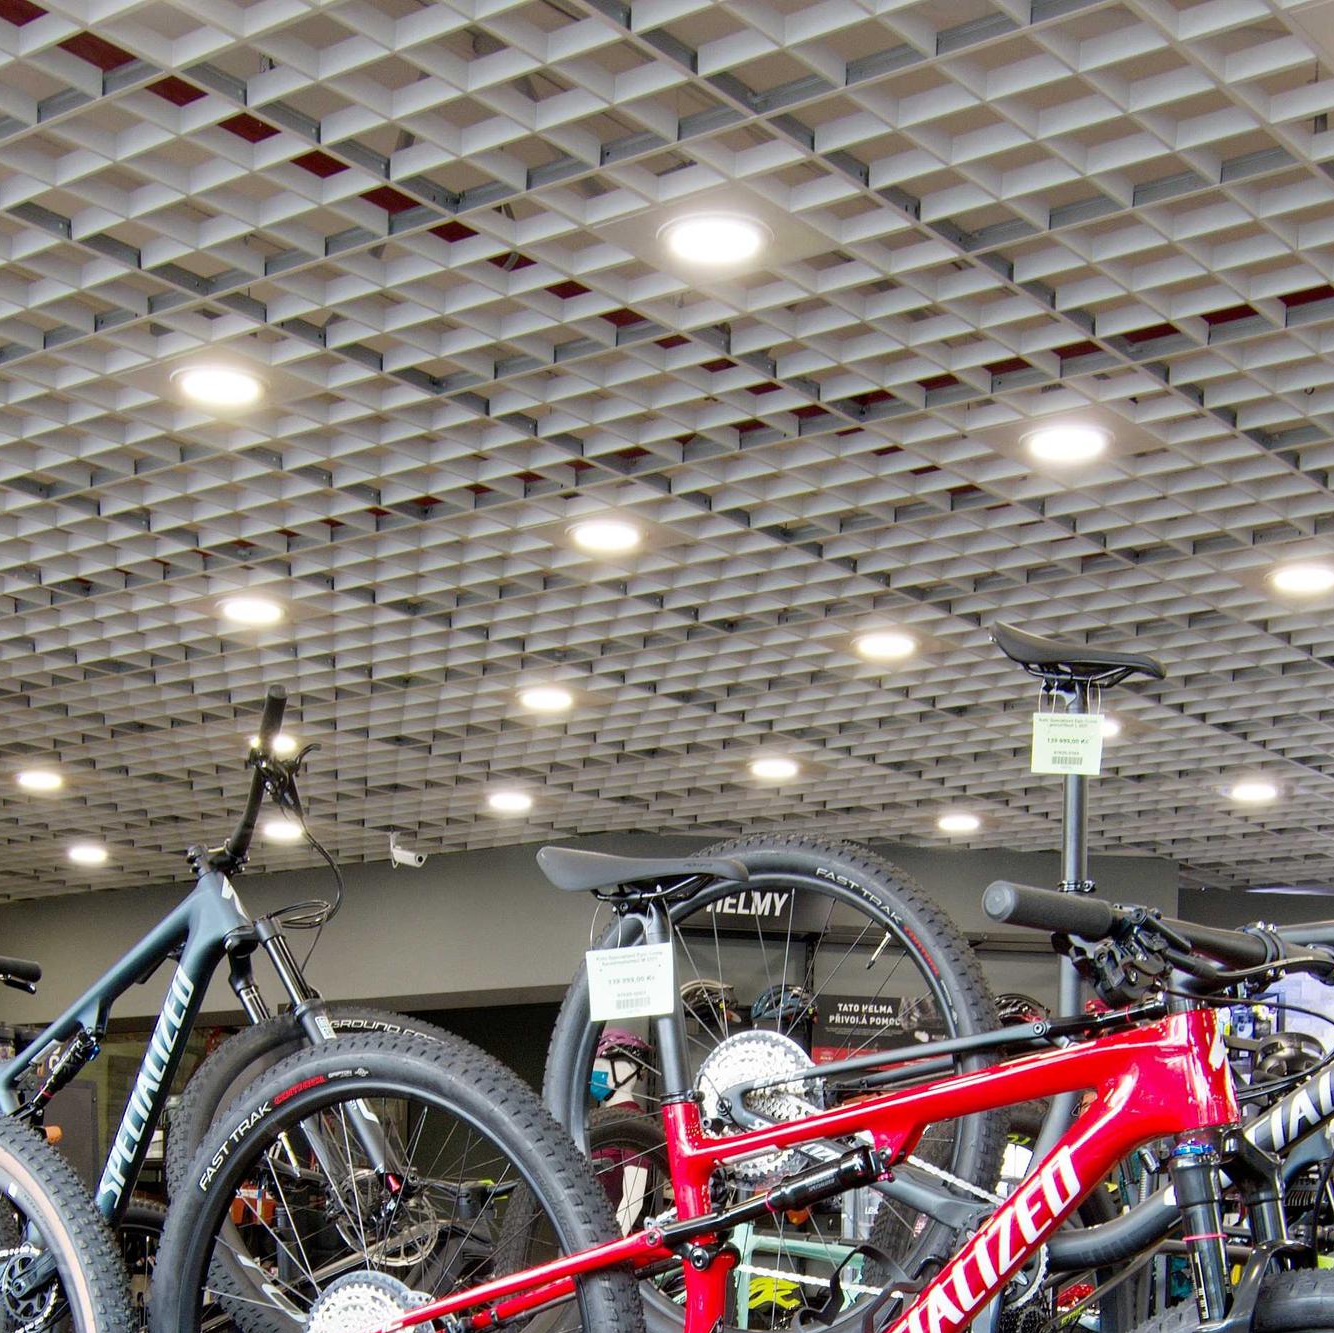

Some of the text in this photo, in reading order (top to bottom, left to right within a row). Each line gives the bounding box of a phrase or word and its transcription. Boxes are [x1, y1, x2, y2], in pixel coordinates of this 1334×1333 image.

[706, 890, 789, 918] HELMY
[816, 867, 858, 891] FAST
[860, 889, 903, 924] TRAK
[330, 1019, 401, 1035] GROUND
[838, 1003, 860, 1014] TATO
[99, 964, 195, 1209] SPECIALIZED
[199, 1139, 230, 1192] FAST
[228, 1101, 272, 1144] TRAK
